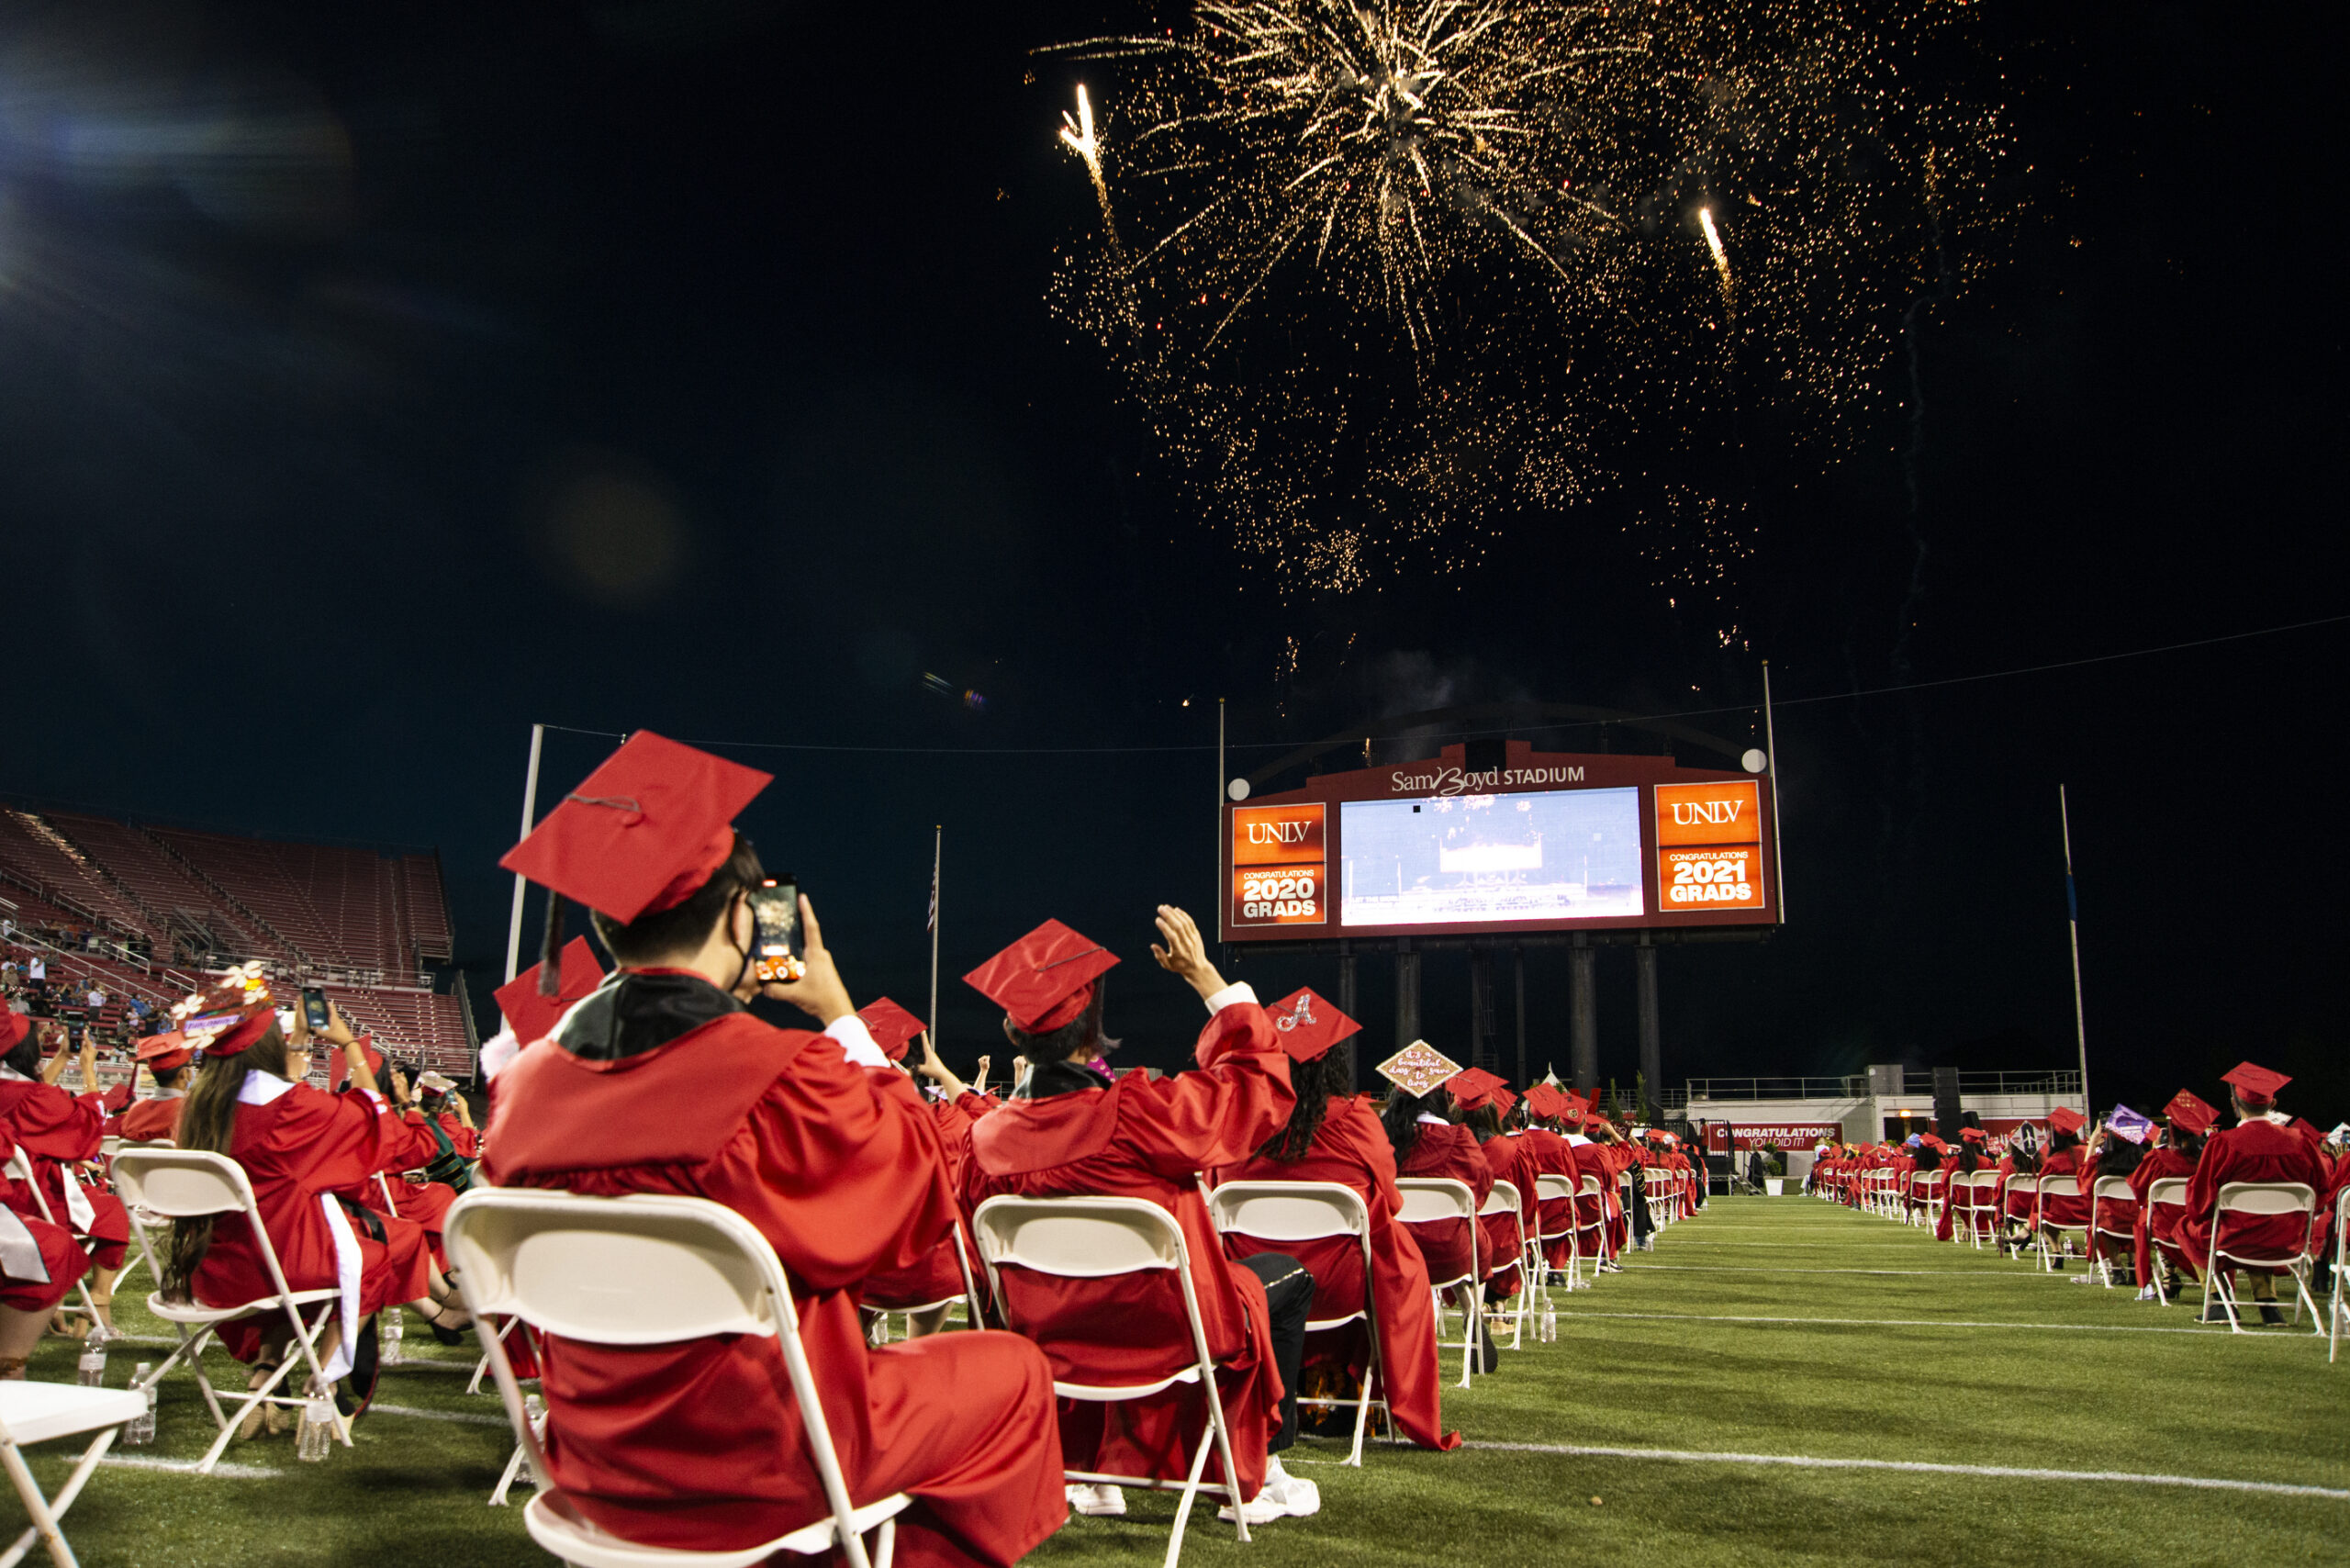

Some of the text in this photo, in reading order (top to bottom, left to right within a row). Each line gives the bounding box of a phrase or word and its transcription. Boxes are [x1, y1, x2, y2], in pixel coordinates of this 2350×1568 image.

[1392, 766, 1584, 796] Sam Boyd STADIUM
[1671, 801, 1744, 824] UNLV
[1246, 821, 1313, 844] UNLV
[1670, 852, 1748, 861] CONGRATULATIONS
[1243, 869, 1315, 879] CONGRATULATIONS
[1673, 859, 1746, 884] 2021
[1243, 878, 1315, 902] 2020
[1670, 882, 1752, 902] GRADS
[1243, 900, 1316, 918] GRADS
[1276, 993, 1317, 1032] A
[1773, 1137, 1792, 1147] DID
